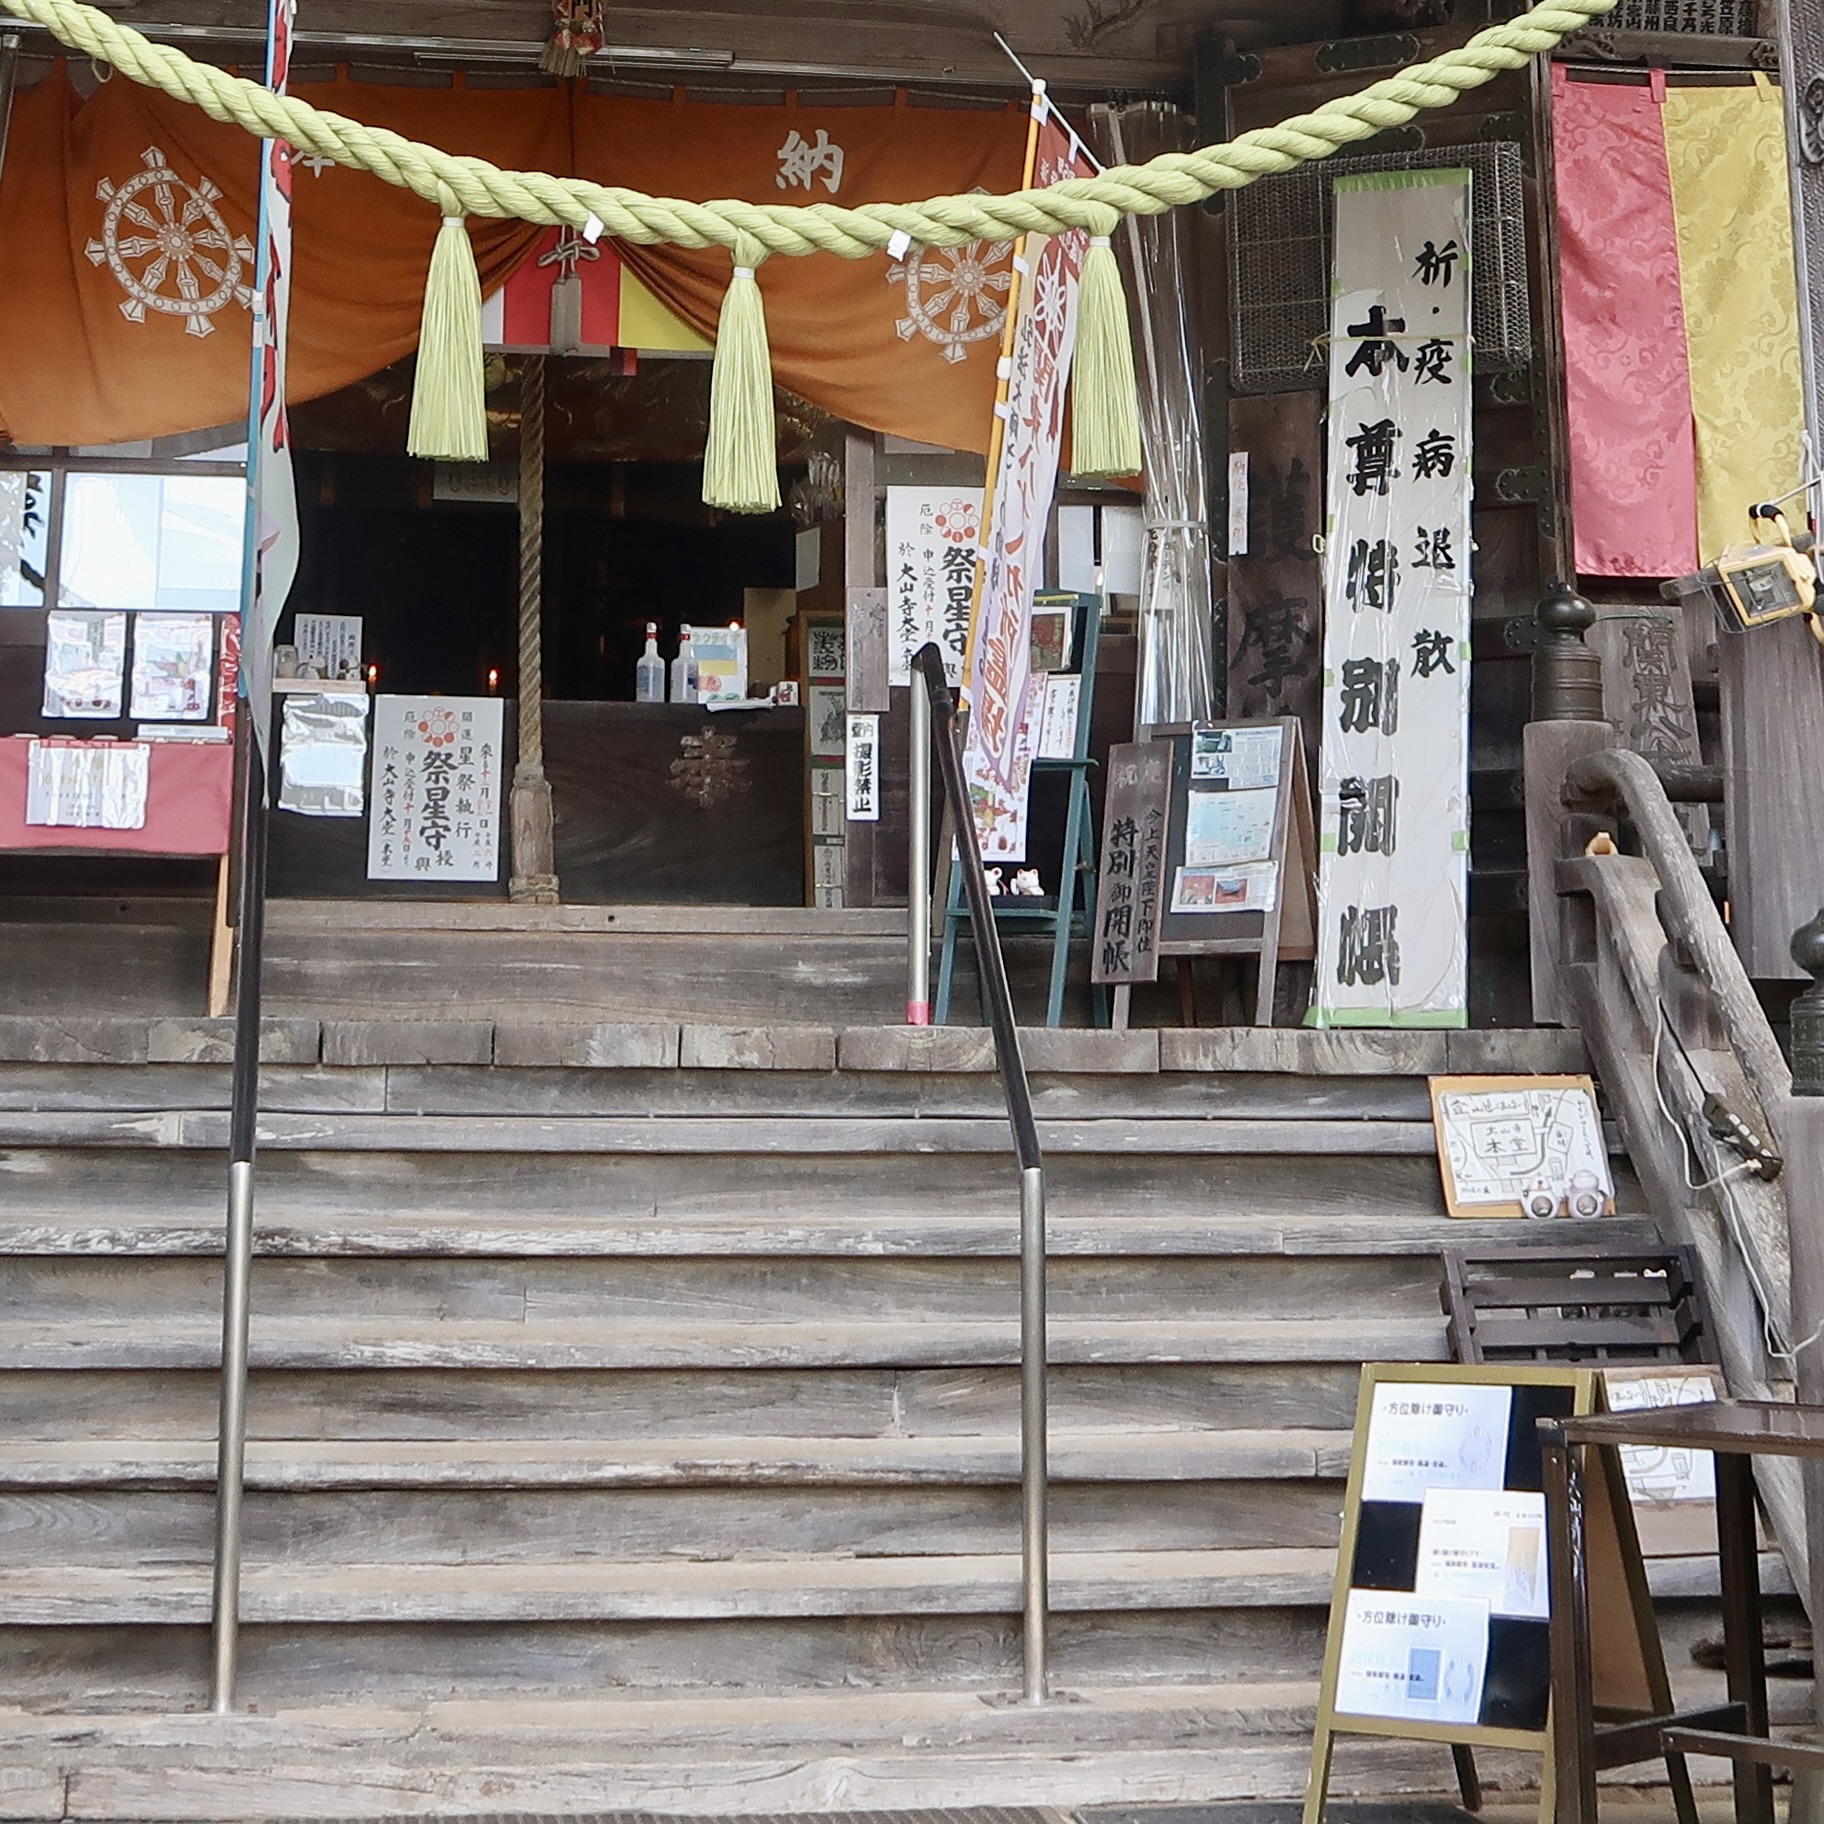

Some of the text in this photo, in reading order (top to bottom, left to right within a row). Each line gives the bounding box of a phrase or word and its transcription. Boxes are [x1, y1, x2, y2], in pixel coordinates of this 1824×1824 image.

[775, 128, 845, 194] 納
[1410, 240, 1459, 681] 祈・疫病退散
[1102, 815, 1139, 975] 特別御開帳
